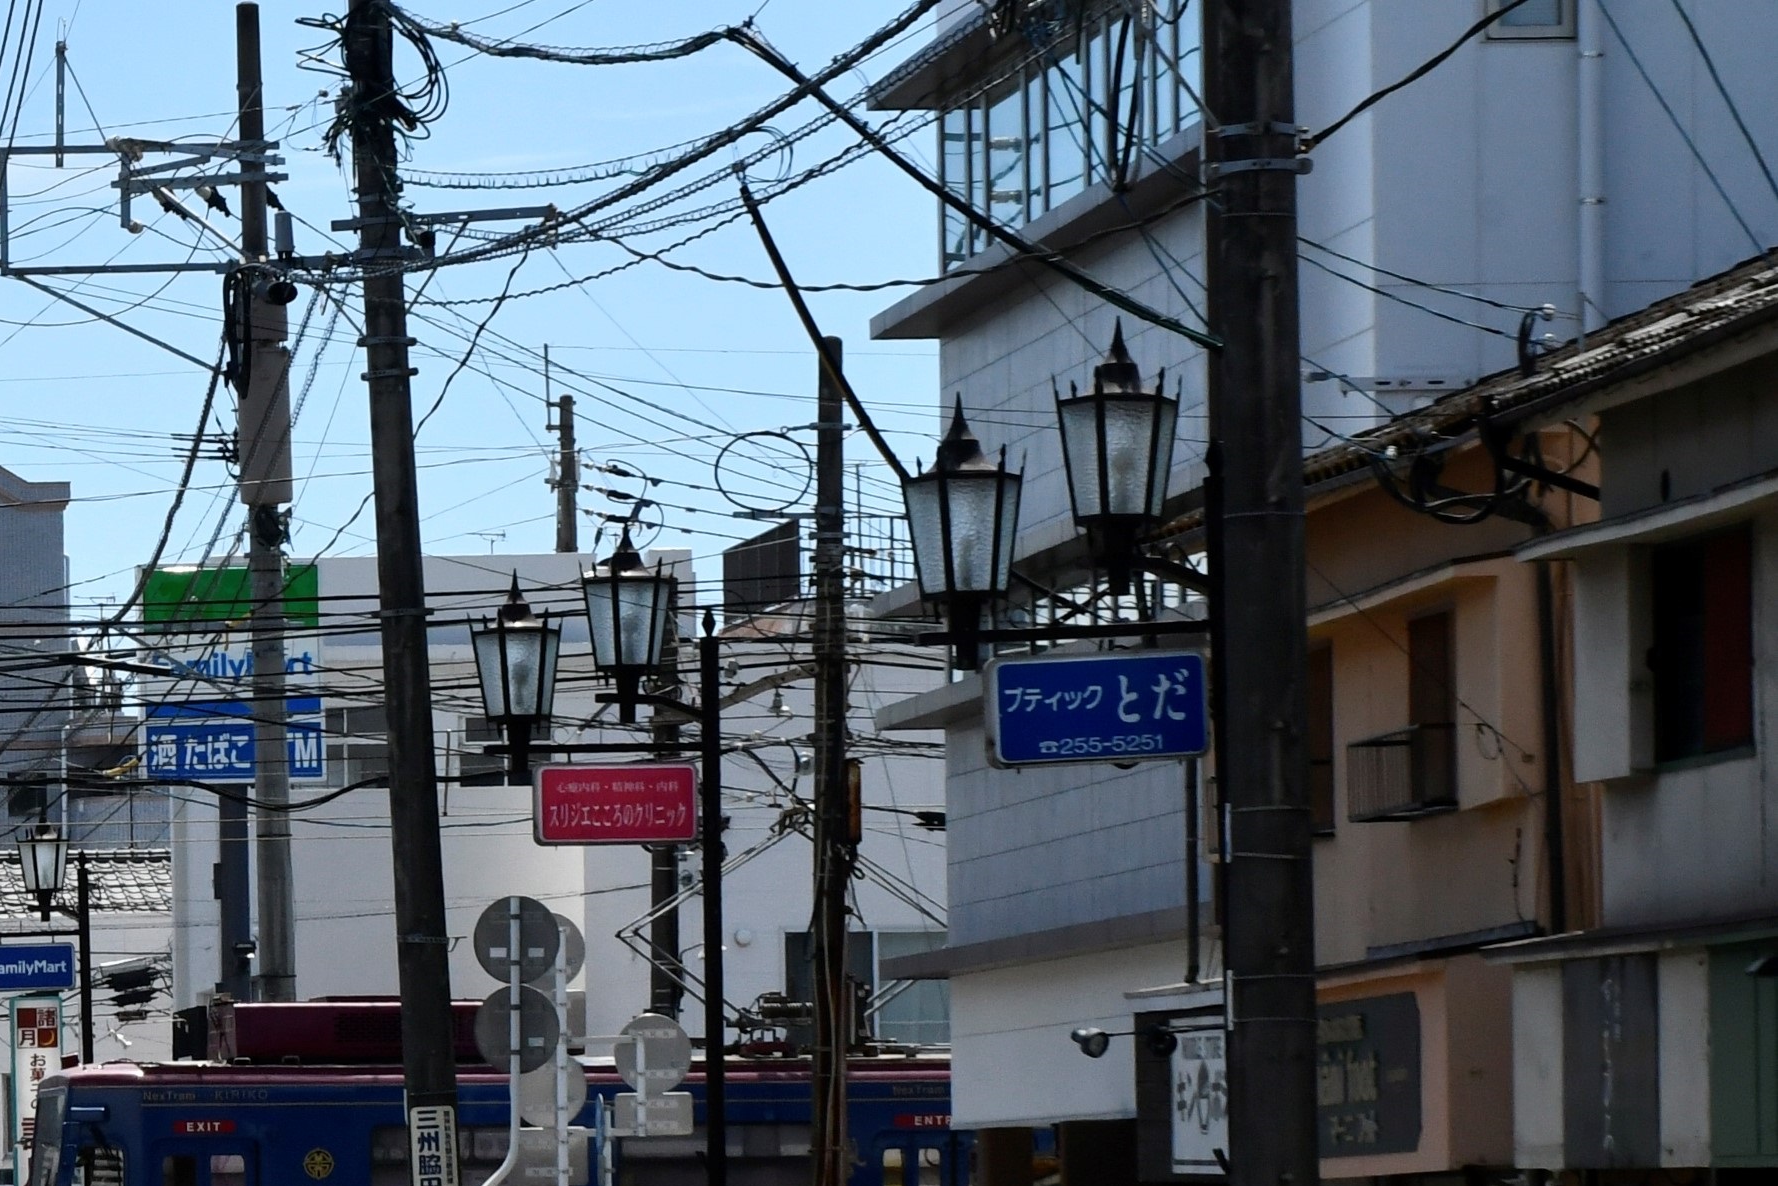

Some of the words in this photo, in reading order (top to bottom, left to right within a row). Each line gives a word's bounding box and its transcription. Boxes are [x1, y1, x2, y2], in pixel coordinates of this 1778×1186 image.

[1117, 668, 1190, 723] とだ
[150, 734, 178, 771] 酒
[184, 733, 252, 771] たばこ
[1060, 734, 1164, 755] 255-5251
[186, 1121, 222, 1132] EXIT
